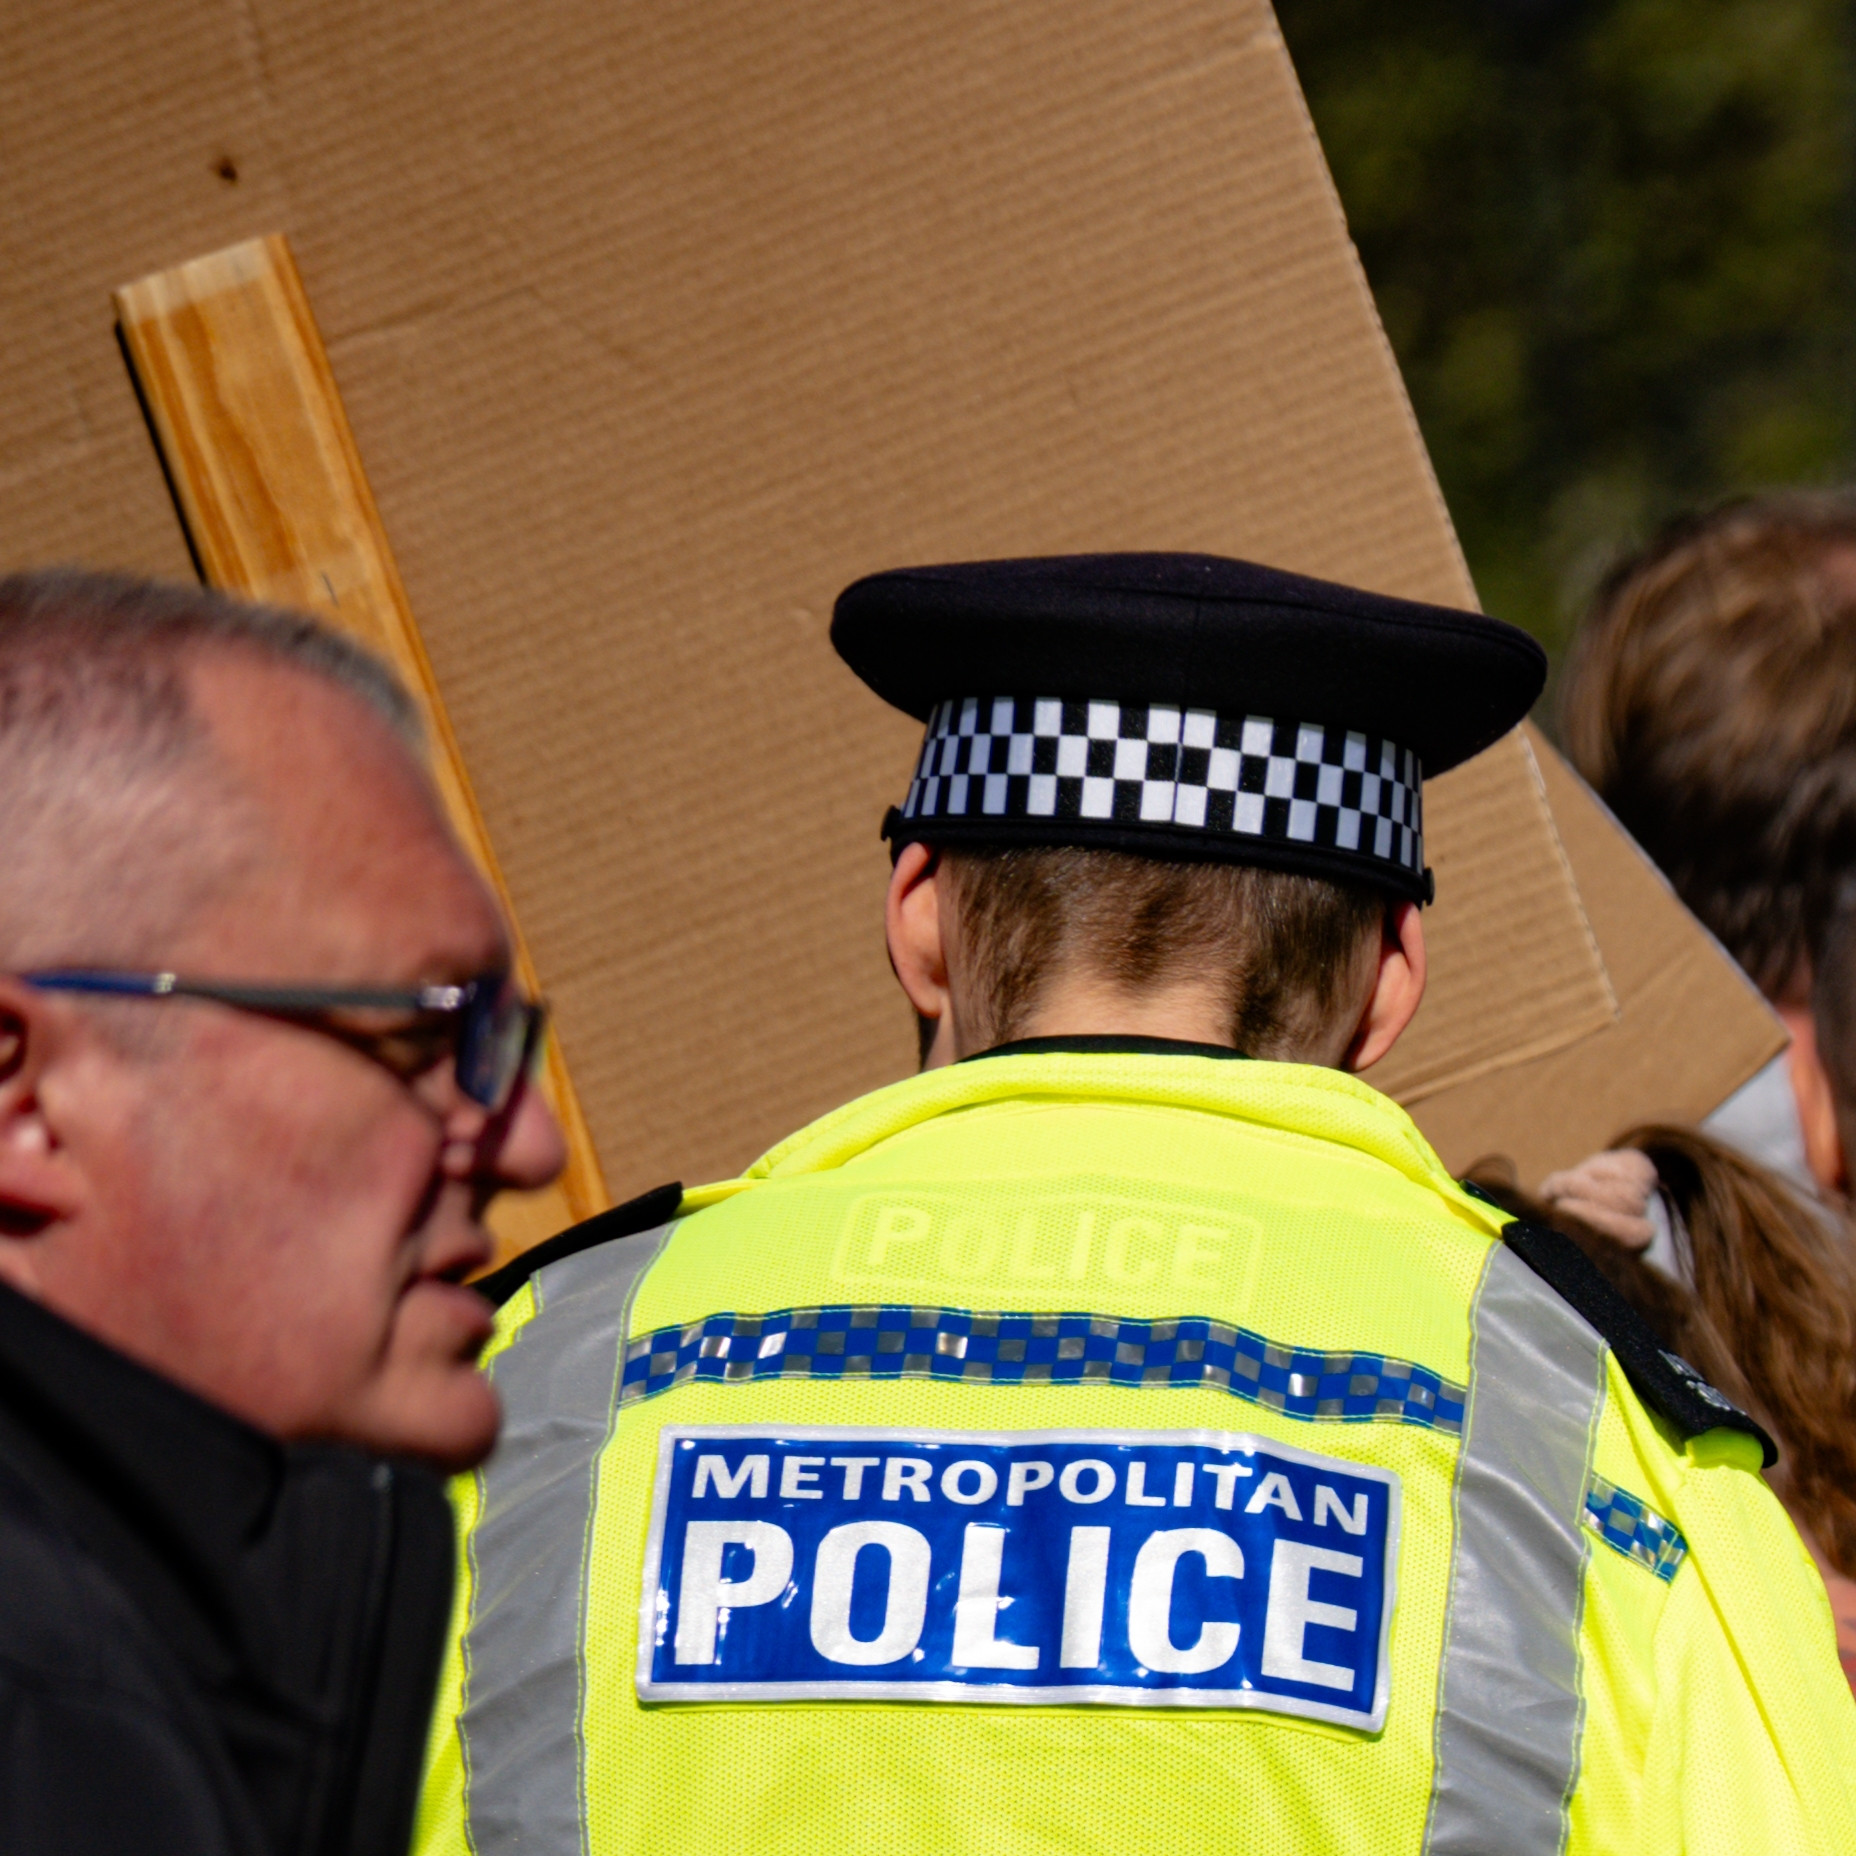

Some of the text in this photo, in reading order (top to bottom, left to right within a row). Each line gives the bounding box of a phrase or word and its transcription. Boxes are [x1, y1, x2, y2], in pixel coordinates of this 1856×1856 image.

[867, 1206, 1232, 1289] POLICE
[691, 1453, 1369, 1537] METROPOLITAN
[674, 1520, 1365, 1692] POLICE
